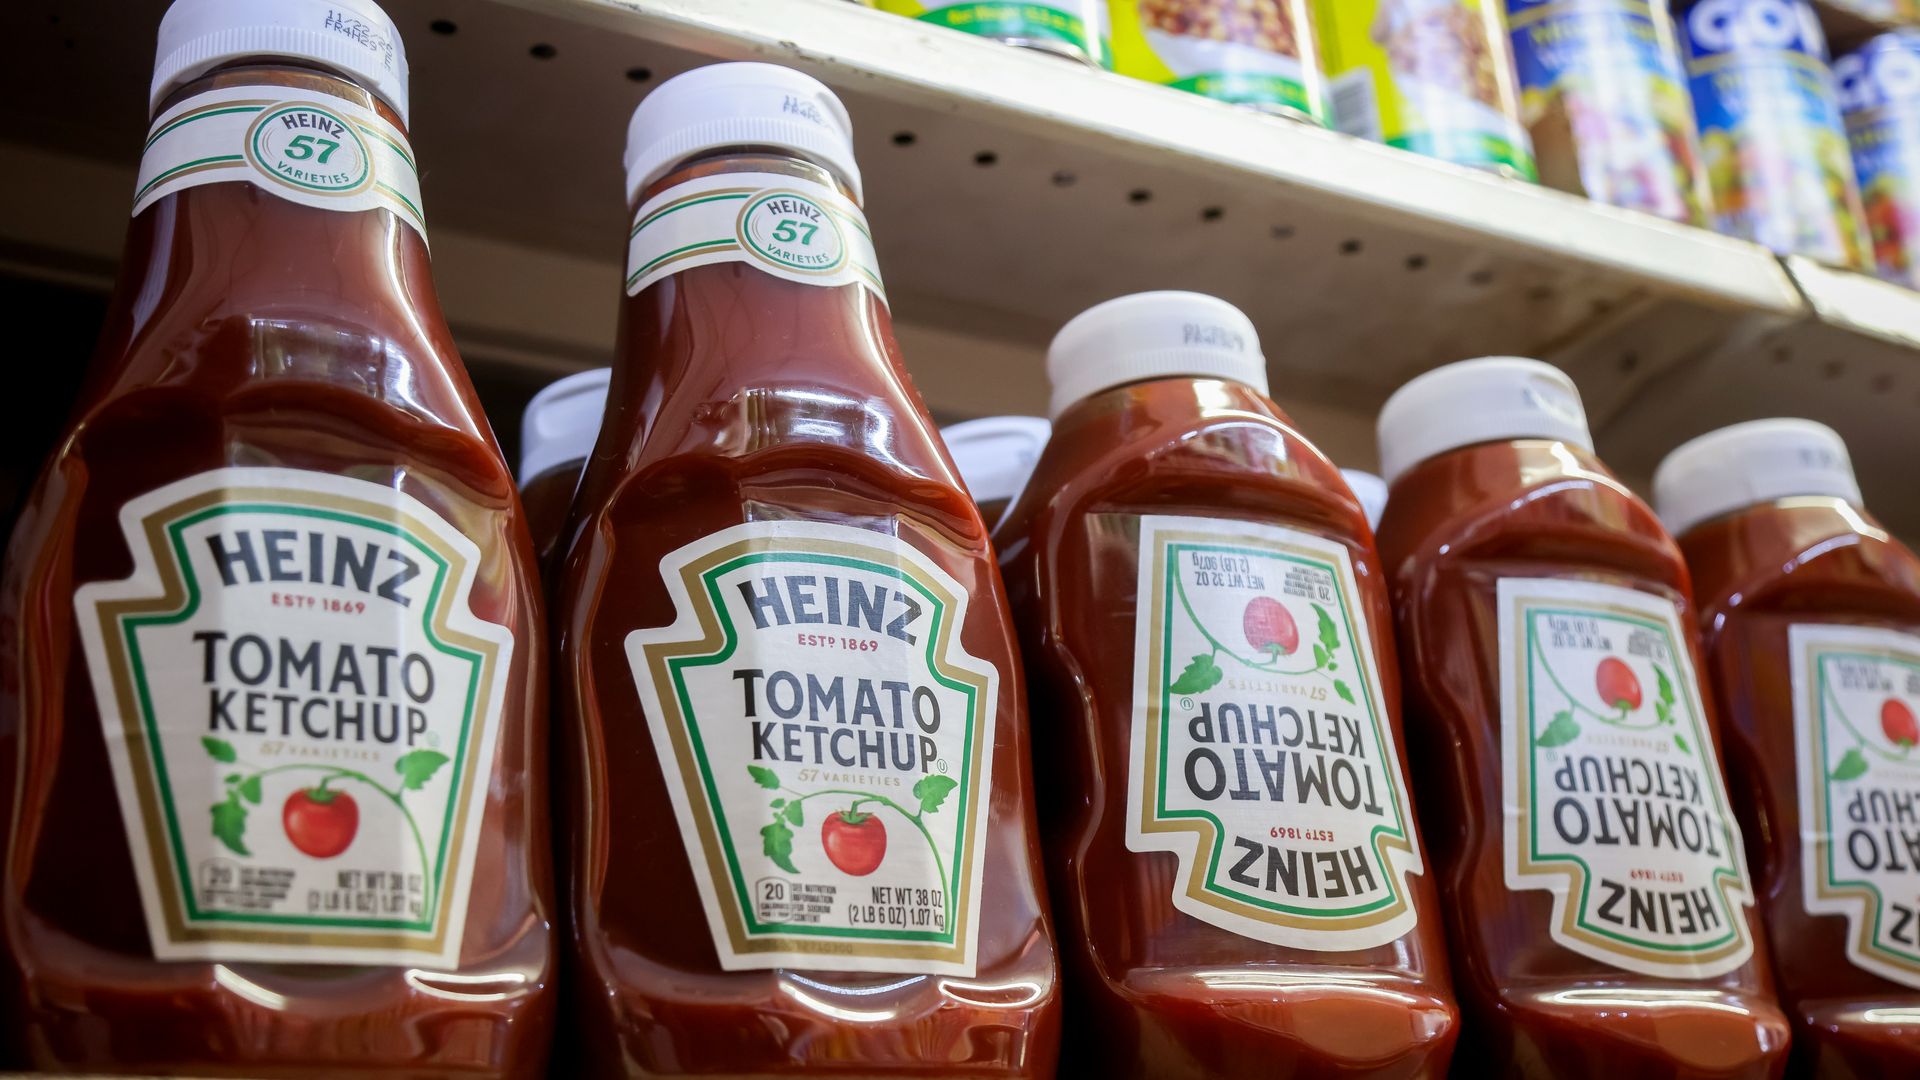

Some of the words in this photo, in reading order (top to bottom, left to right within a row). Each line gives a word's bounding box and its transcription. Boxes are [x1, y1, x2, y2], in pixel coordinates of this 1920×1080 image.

[281, 114, 345, 139] HEINZ
[284, 134, 340, 164] 57
[277, 161, 350, 184] VARIETIES
[767, 200, 820, 223] HEINZ
[772, 219, 818, 246] 57
[767, 243, 829, 264] VARIETIES
[206, 530, 421, 608] HEINZ
[1195, 571, 1209, 587] OZ
[1211, 571, 1225, 587] 32
[1228, 573, 1245, 589] WT
[1247, 575, 1265, 591] NET
[323, 598, 366, 614] 1869
[737, 576, 922, 647] HEINZ
[841, 637, 878, 652] 1869
[193, 630, 435, 704] TOMATO
[733, 669, 940, 734] TOMATO
[1310, 687, 1328, 700] 57
[209, 689, 427, 747] KETCHUP
[1188, 702, 1366, 759] KETCHUP
[751, 721, 937, 773] KETCHUP
[798, 768, 819, 782] 57
[823, 772, 900, 787] VARIETIES
[1184, 747, 1384, 816] TOMATO
[1555, 755, 1704, 806] KETCHUP
[1270, 827, 1302, 840] 1869
[1553, 797, 1721, 858] TOMATO
[1228, 836, 1378, 899] HEINZ
[765, 883, 784, 900] 20
[872, 886, 891, 905] NET
[895, 887, 912, 906] WT
[916, 888, 928, 907] 38
[932, 890, 943, 908] OZ
[848, 904, 859, 926] (2
[863, 905, 875, 923] LB
[879, 906, 885, 924] 6
[888, 906, 907, 928] OZ)
[911, 908, 930, 926] 1.07
[933, 910, 944, 932] kg
[1597, 878, 1721, 935] HEINZ
